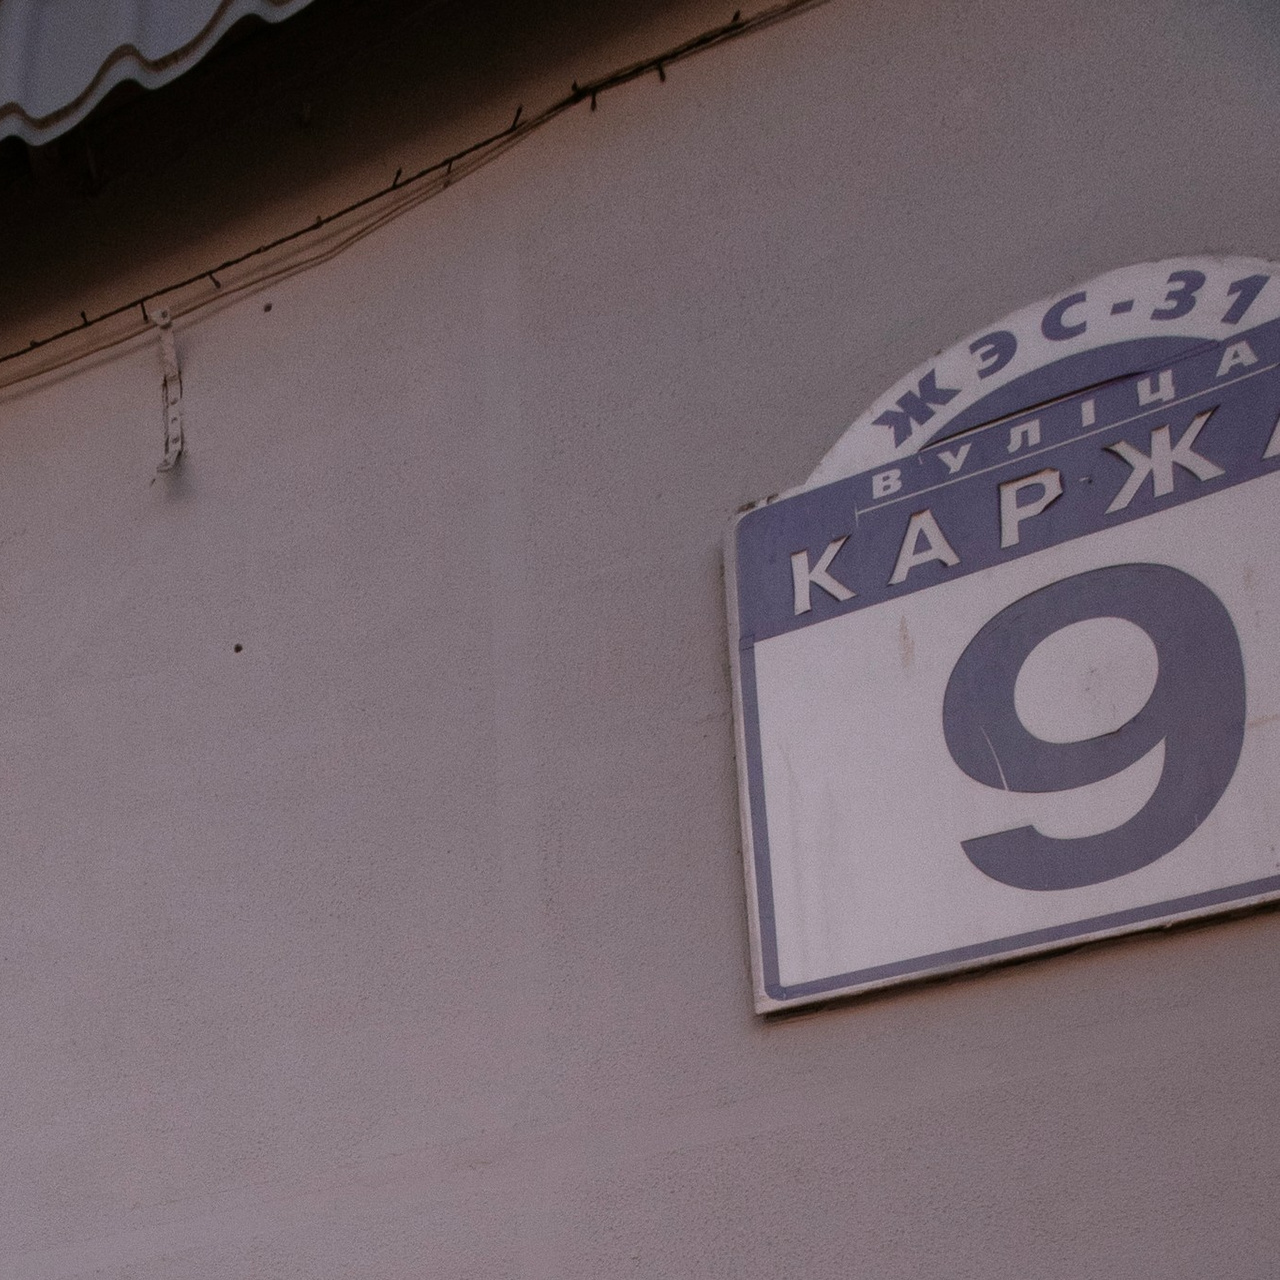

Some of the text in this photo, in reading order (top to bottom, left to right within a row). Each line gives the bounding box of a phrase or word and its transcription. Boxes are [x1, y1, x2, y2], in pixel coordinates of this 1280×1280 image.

[872, 270, 1270, 449] ЖЭС-31
[872, 339, 1259, 500] ВУЛІЦА
[790, 406, 1280, 615] КАРЖ
[942, 561, 1248, 892] 9
